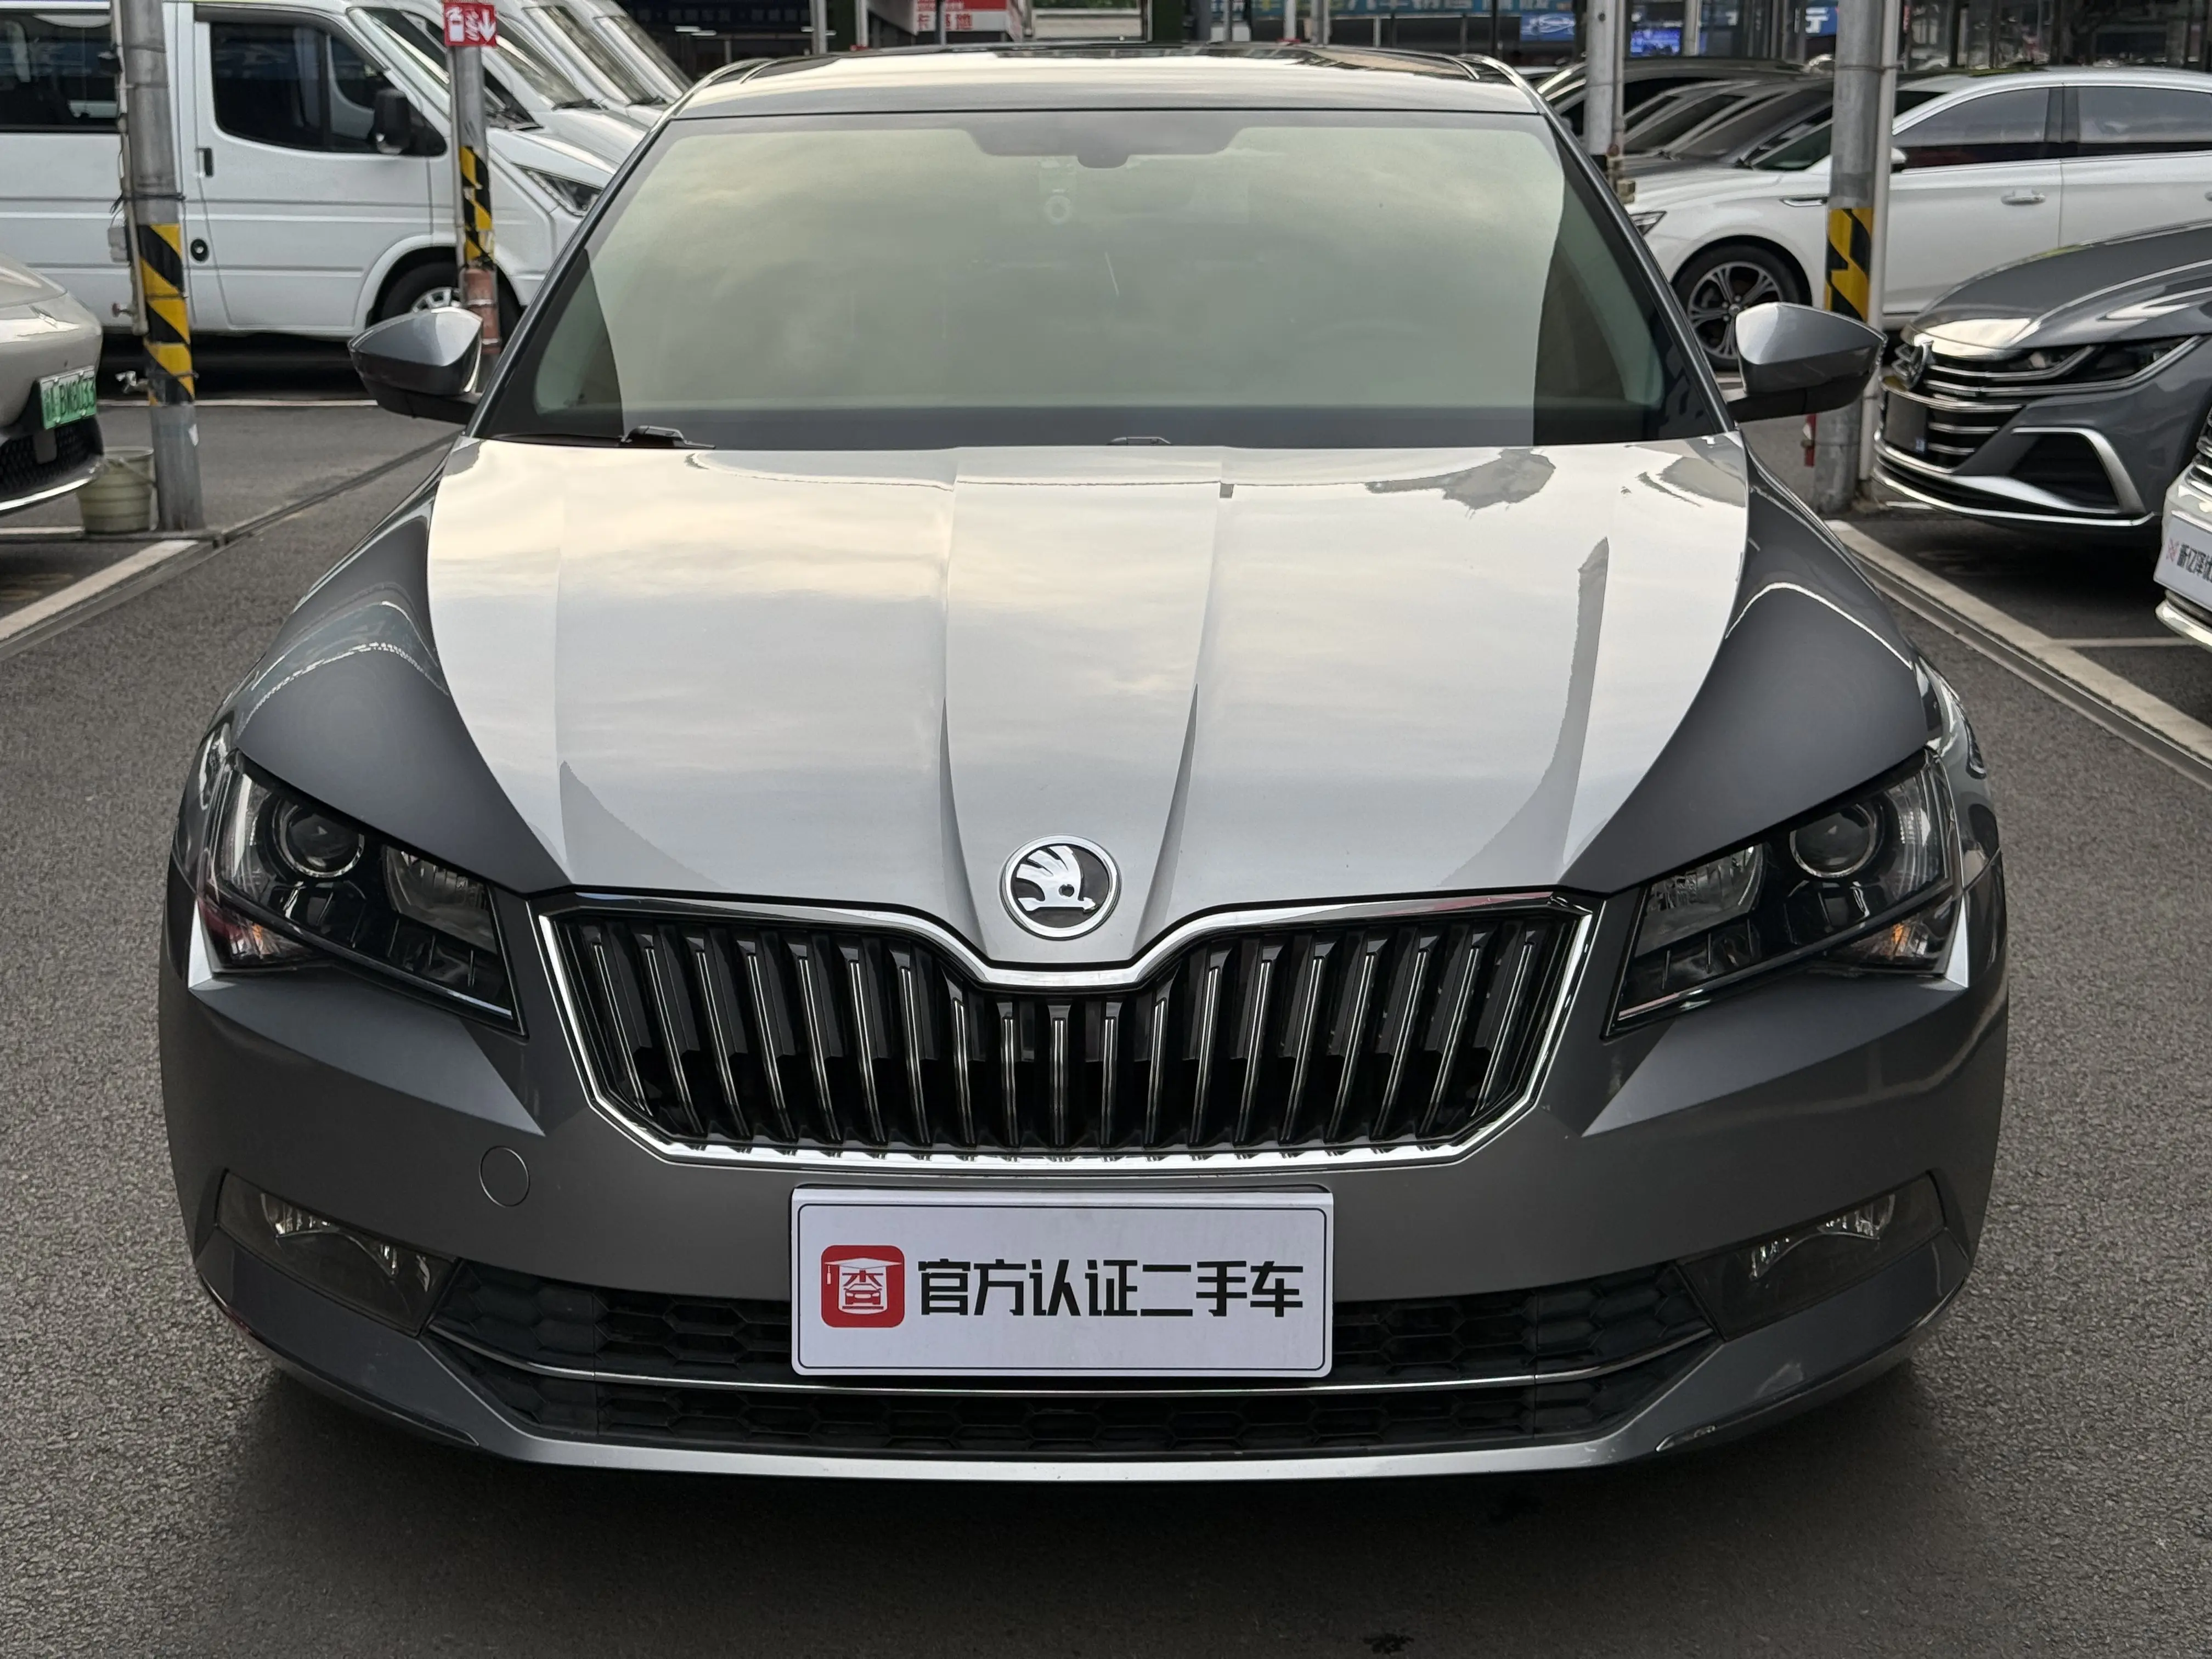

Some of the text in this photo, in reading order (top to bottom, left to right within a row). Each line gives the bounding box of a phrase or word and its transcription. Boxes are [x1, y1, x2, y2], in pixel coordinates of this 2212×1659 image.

[918, 1259, 1304, 1317] 官方认证二手车
